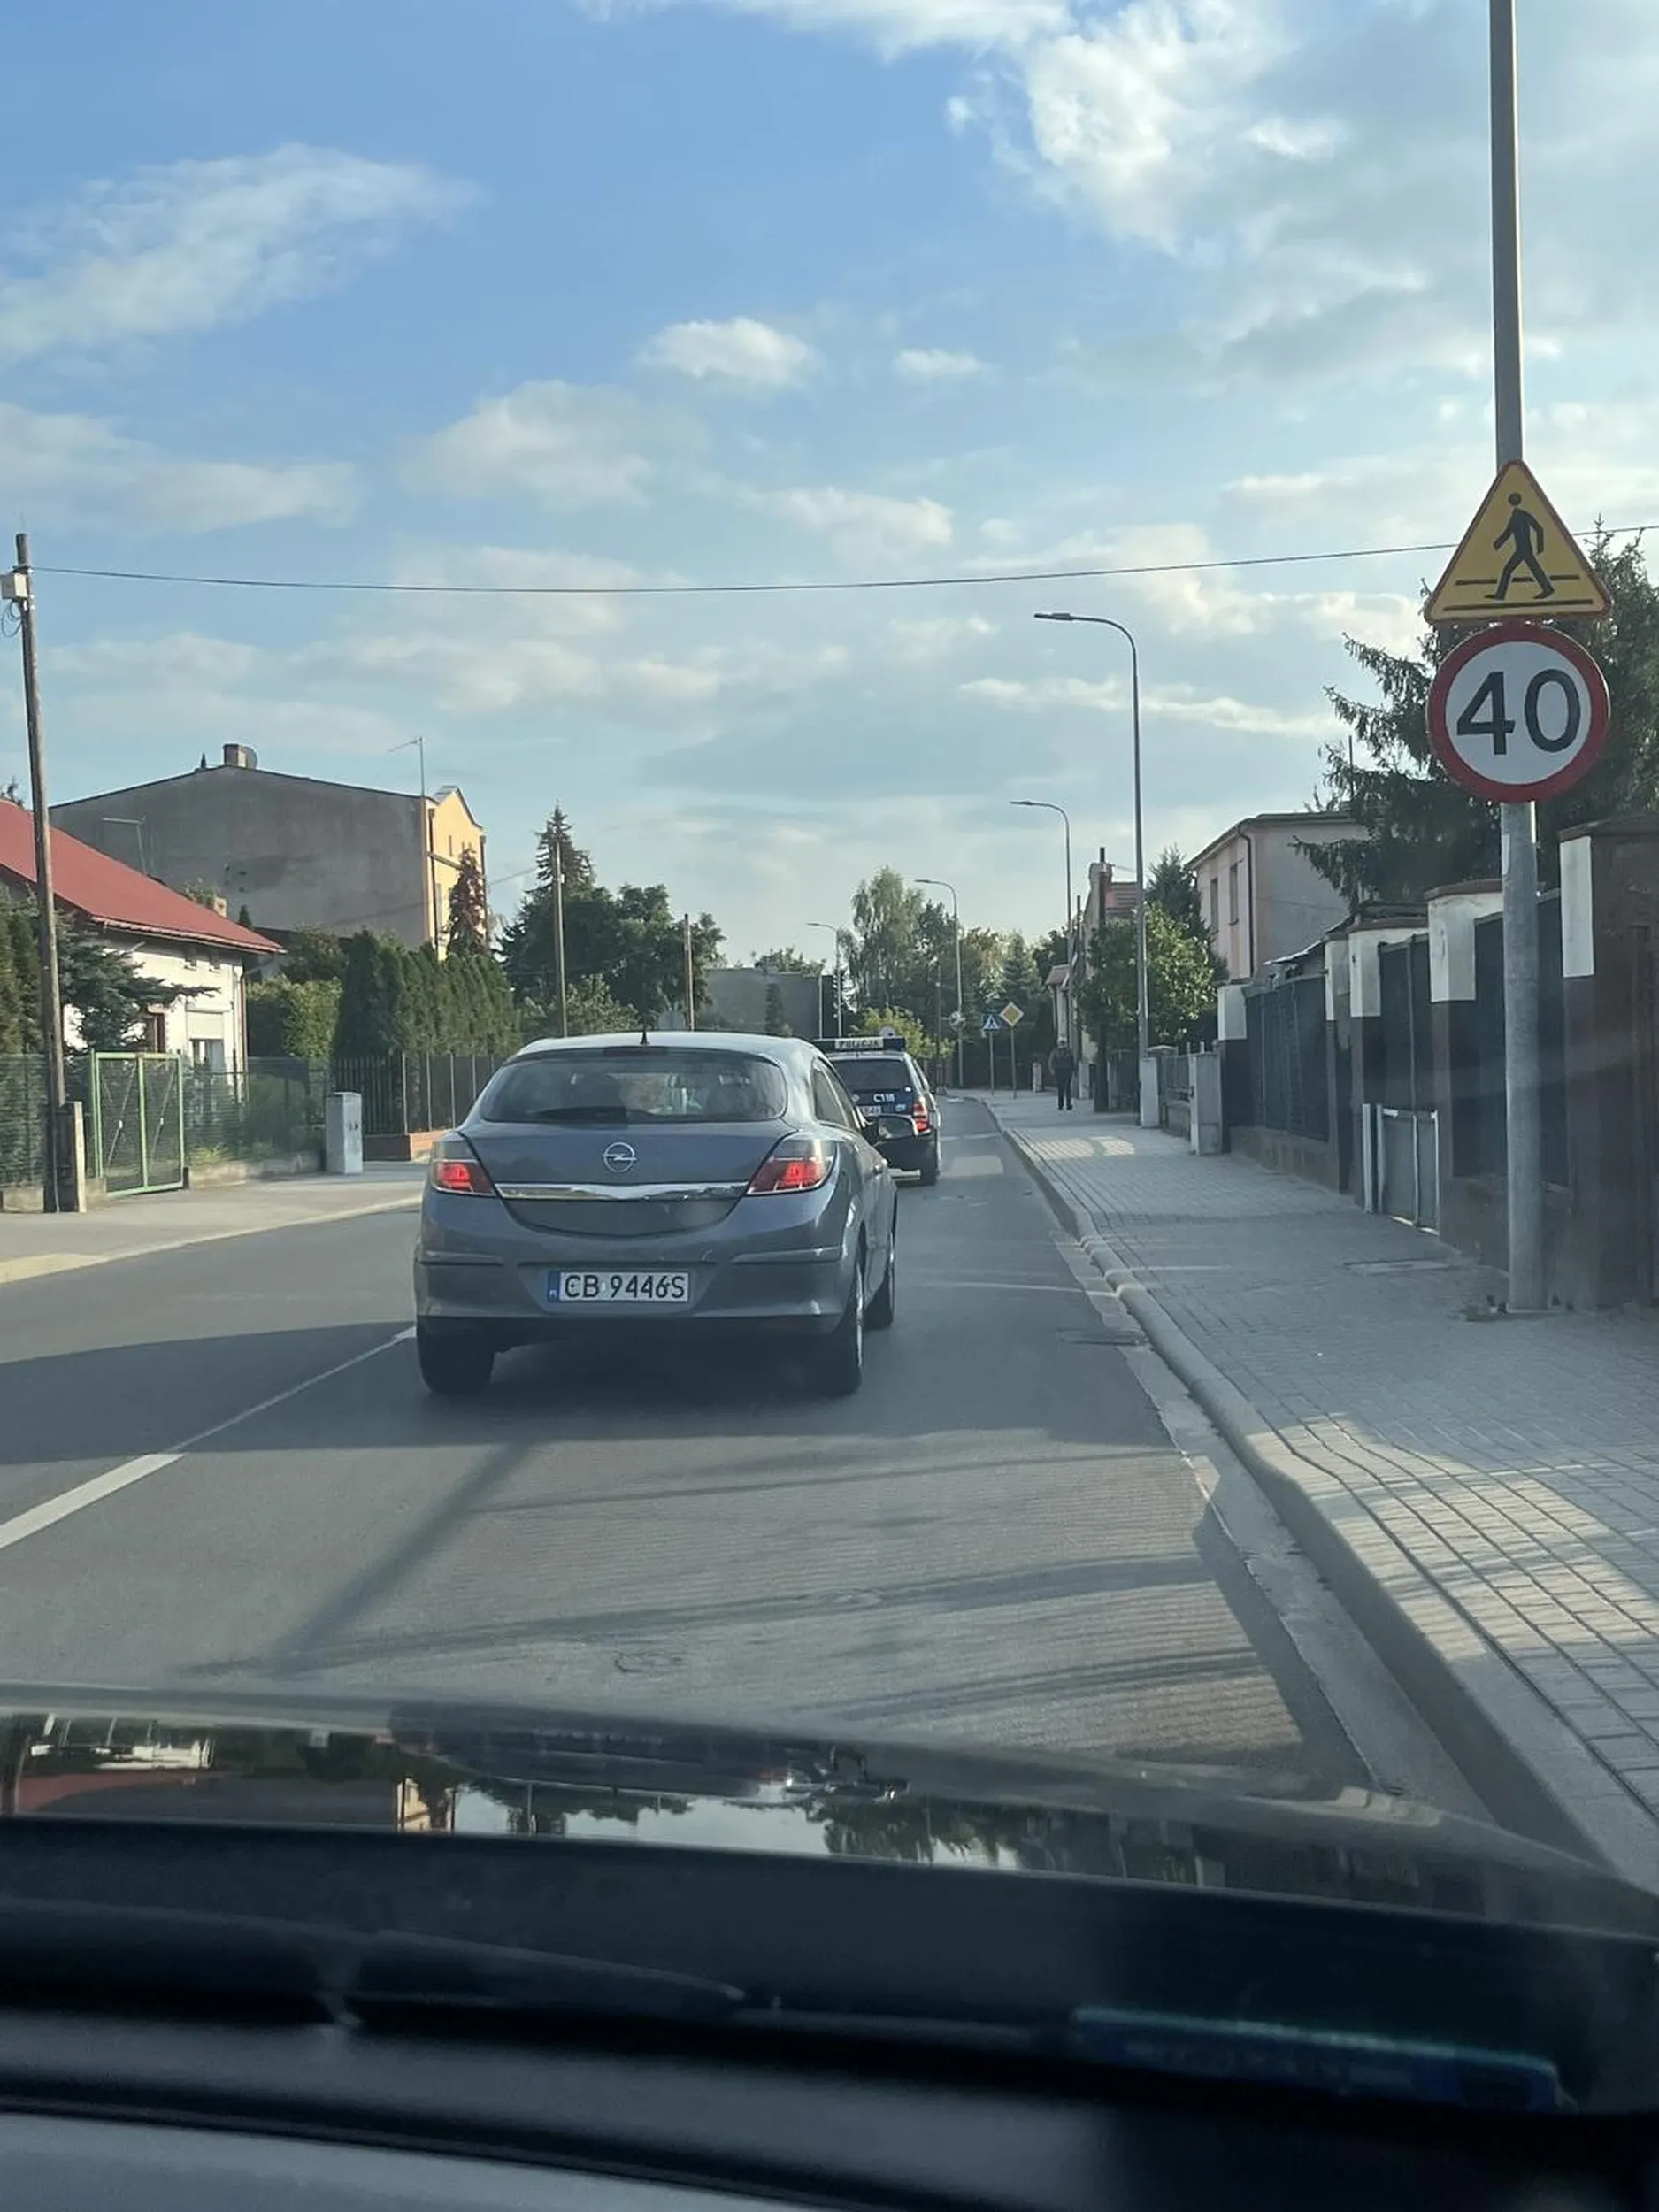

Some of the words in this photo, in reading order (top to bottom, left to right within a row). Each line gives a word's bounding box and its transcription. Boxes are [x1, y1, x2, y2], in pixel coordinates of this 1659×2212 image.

[1456, 668, 1582, 756] 40
[565, 1274, 600, 1299] CB
[610, 1274, 686, 1300] 9446S
